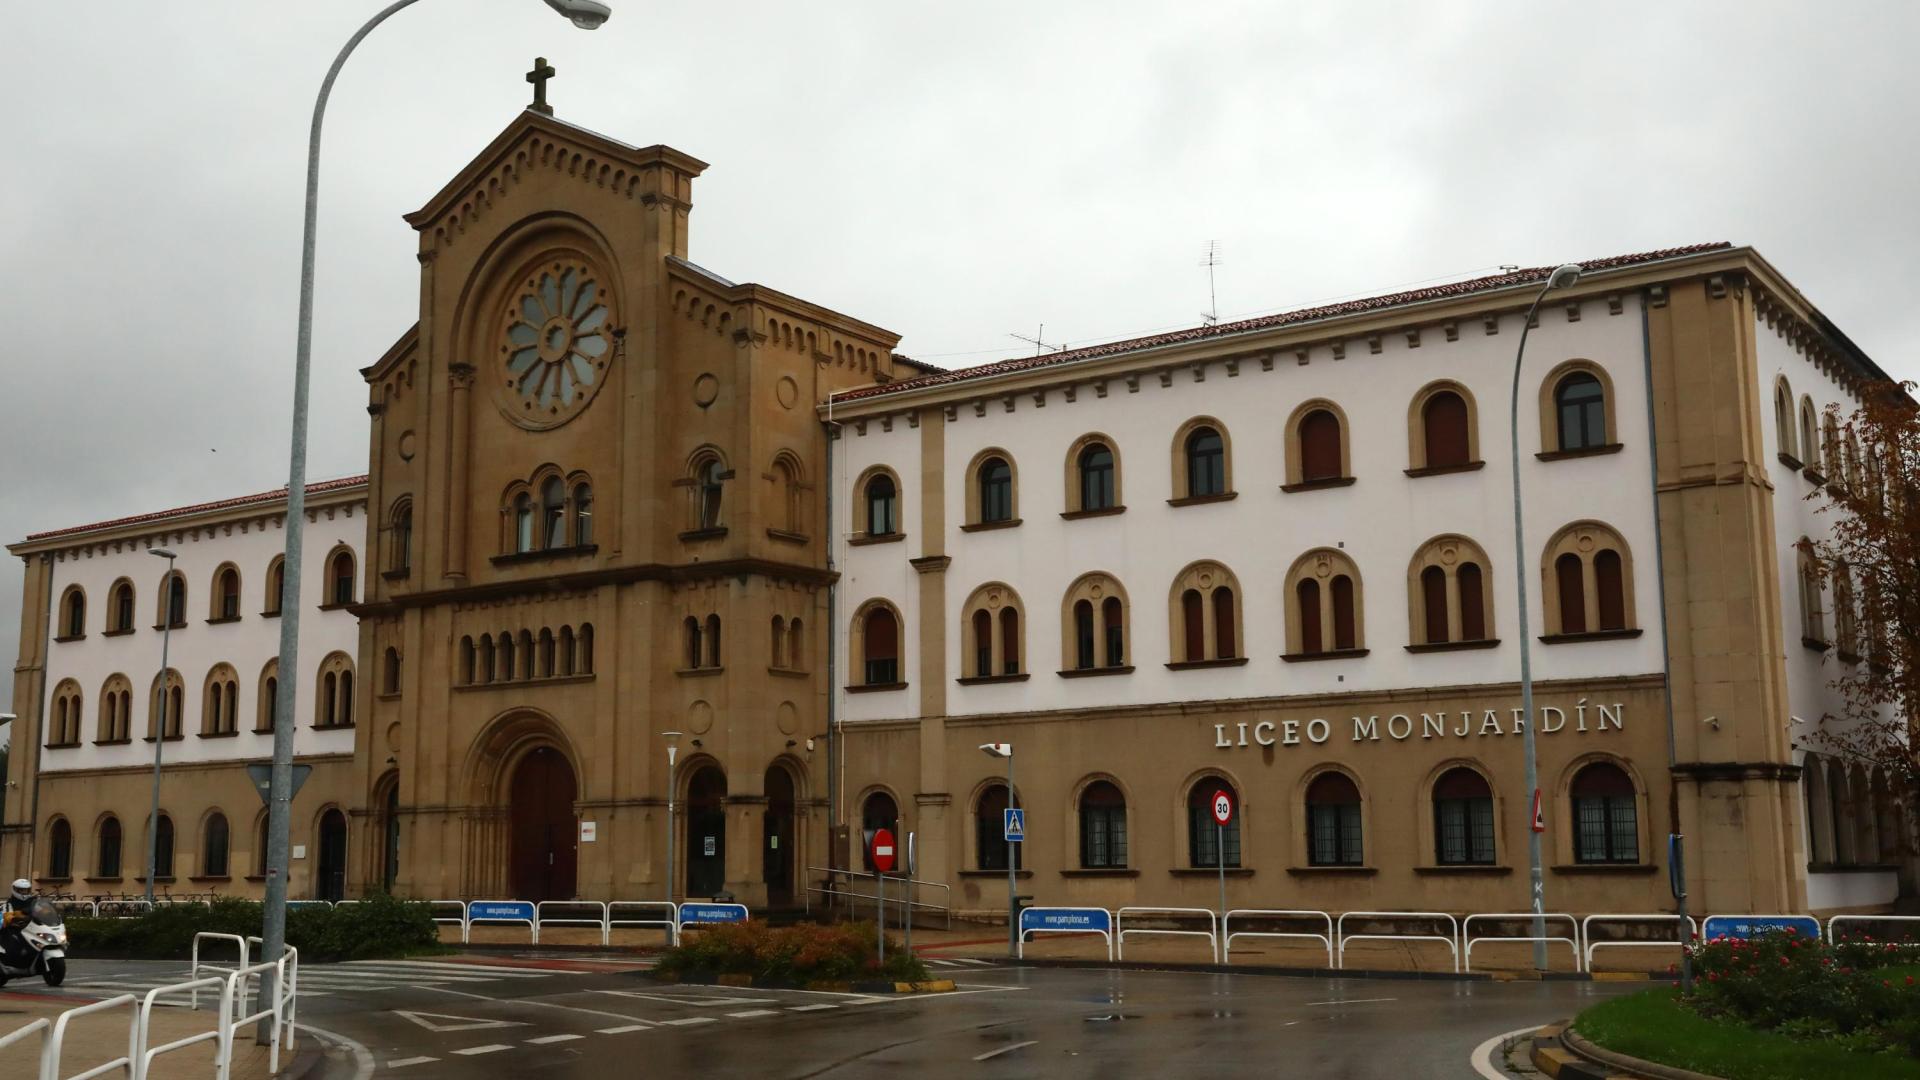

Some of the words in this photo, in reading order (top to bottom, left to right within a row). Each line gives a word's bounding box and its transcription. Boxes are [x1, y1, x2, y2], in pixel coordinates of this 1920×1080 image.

[1215, 719, 1330, 747] LICEO
[1352, 698, 1624, 741] MONJARDÍN
[1217, 803, 1228, 814] 30
[1045, 914, 1090, 925] www.pamplona.es
